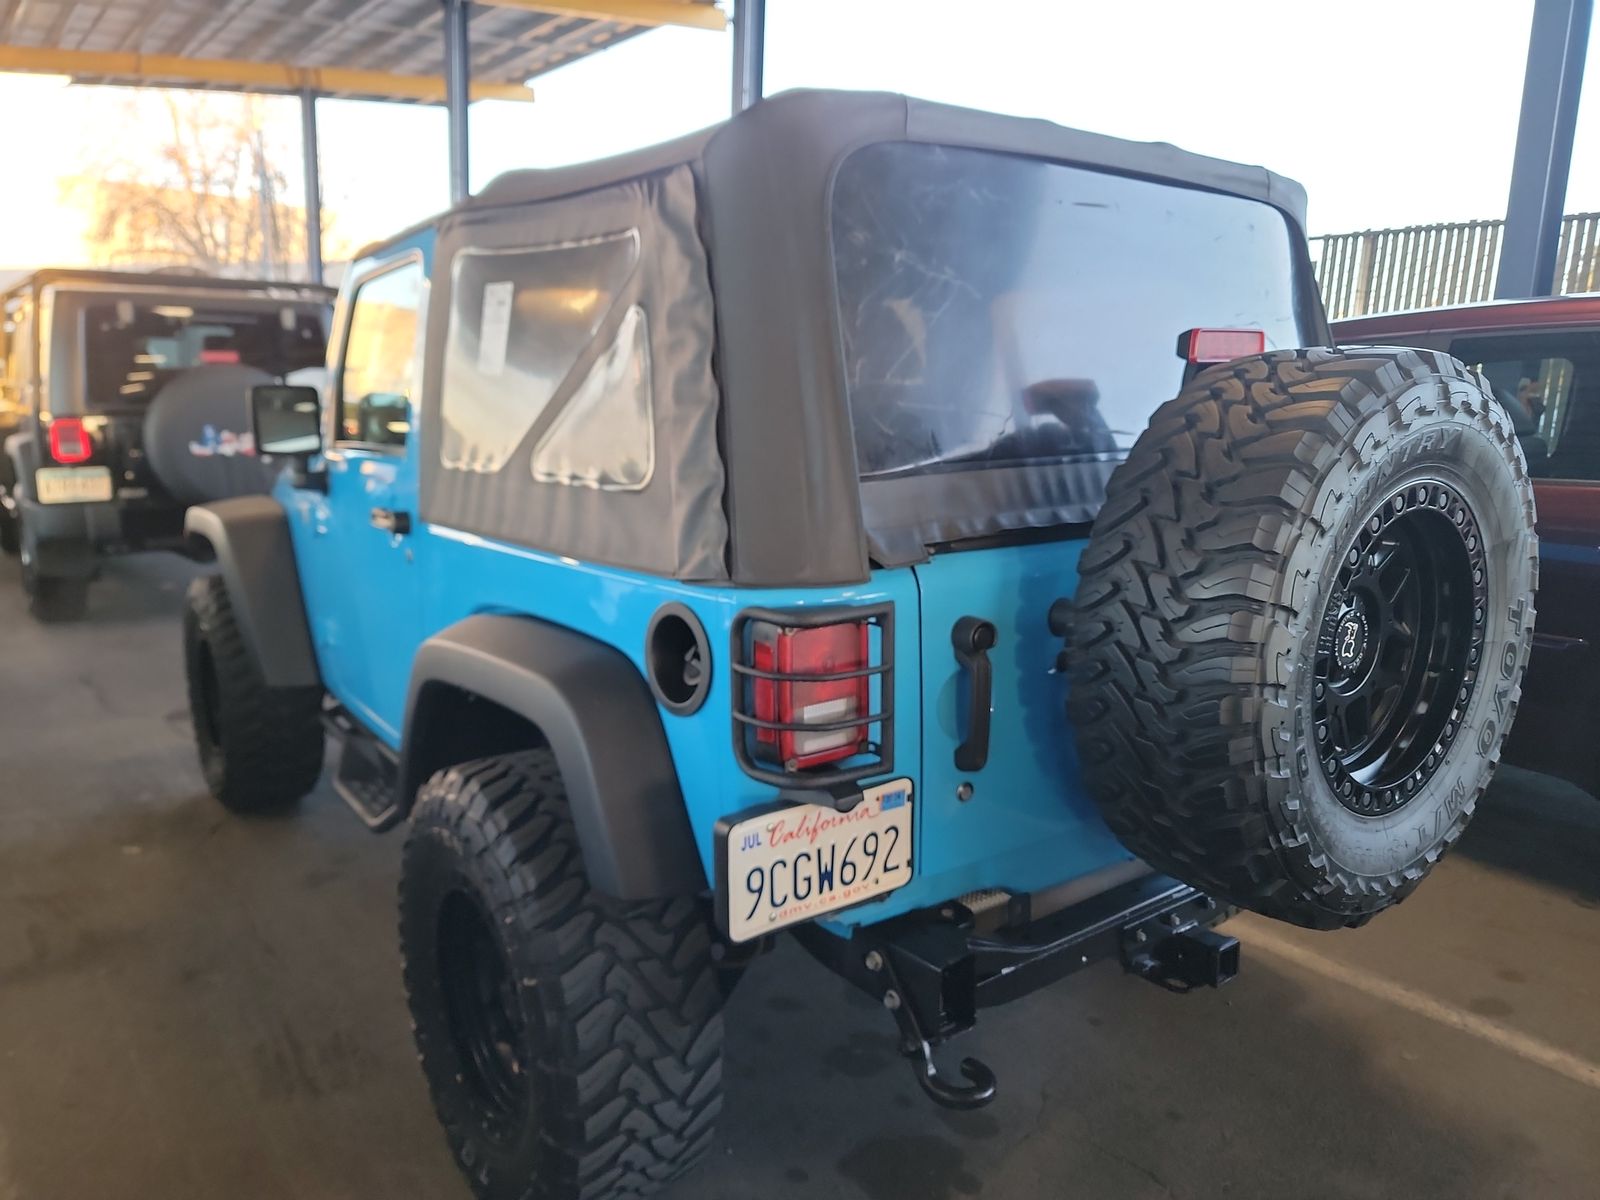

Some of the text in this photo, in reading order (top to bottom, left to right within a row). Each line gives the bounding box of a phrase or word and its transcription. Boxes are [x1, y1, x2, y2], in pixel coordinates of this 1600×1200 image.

[1477, 598, 1526, 759] TOYO
[768, 806, 880, 848] California
[1413, 775, 1467, 843] M/T
[741, 832, 762, 851] JUL
[745, 825, 900, 921] 9CGW692
[778, 882, 871, 919] dmv.ca.gov
